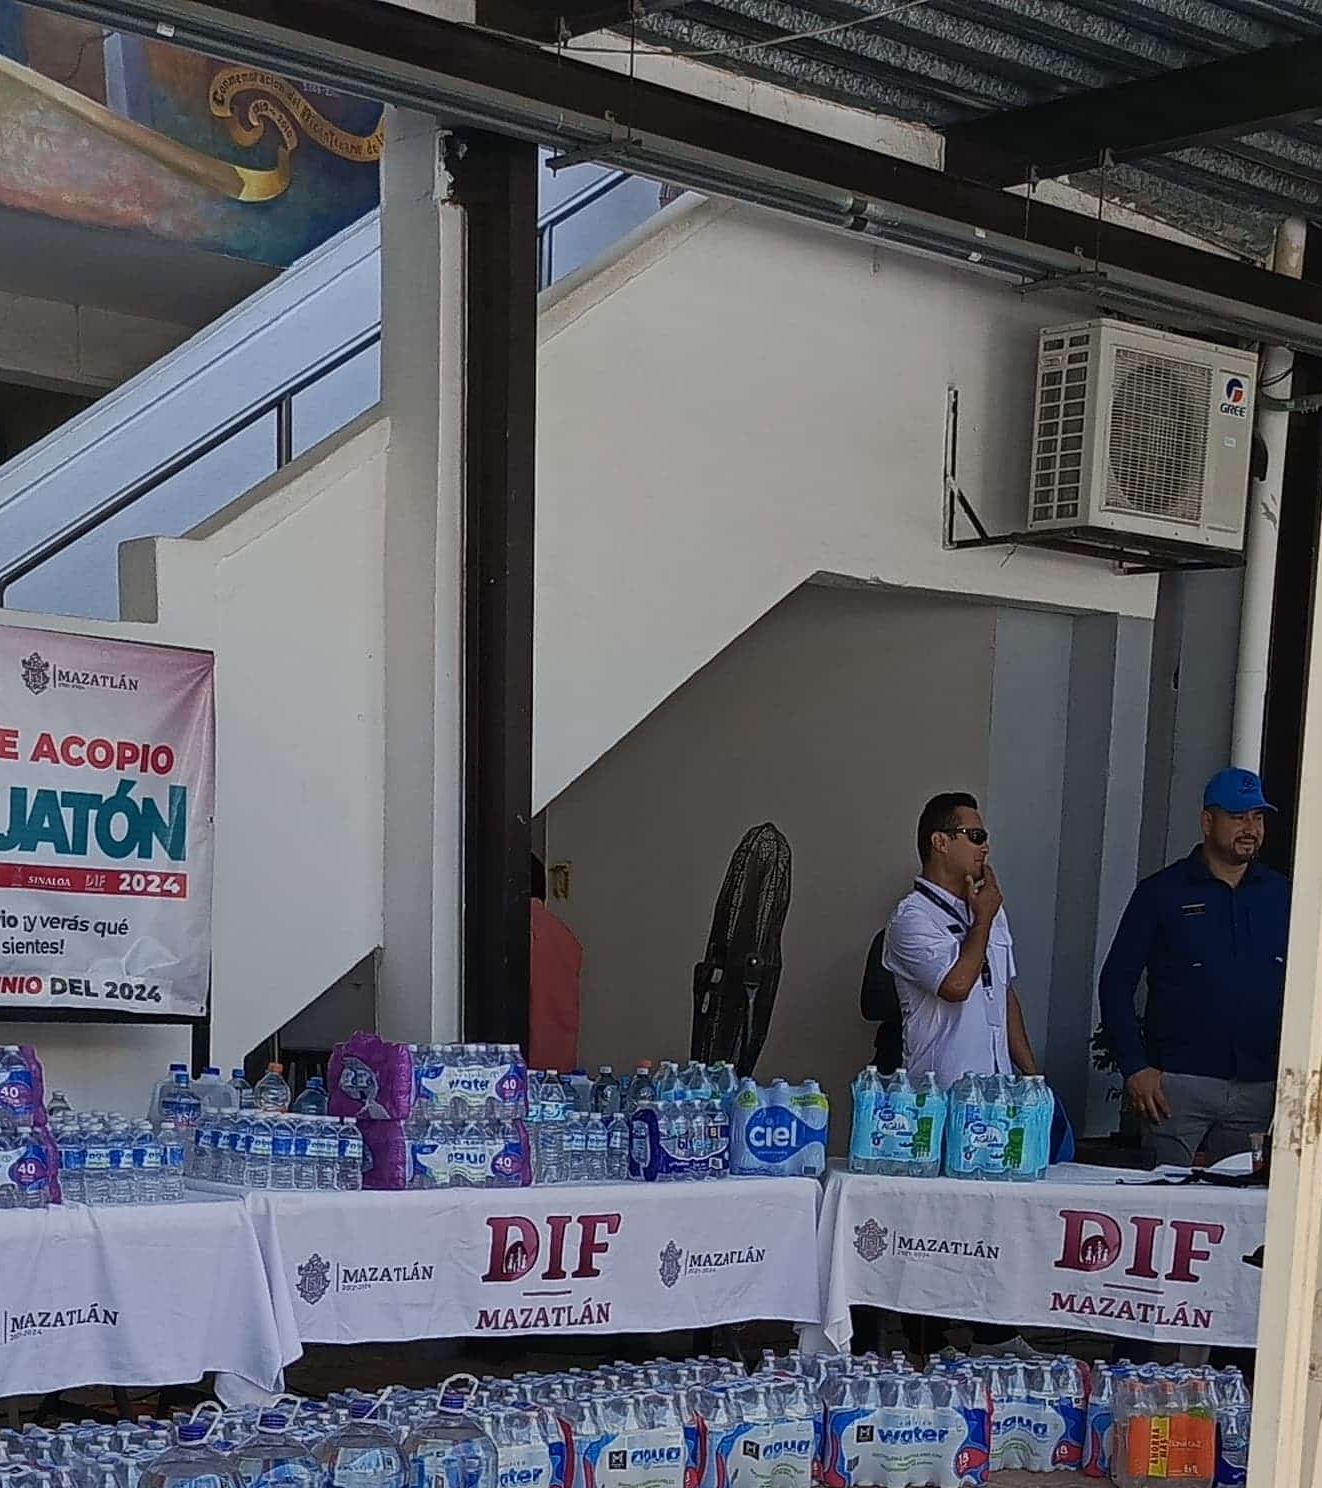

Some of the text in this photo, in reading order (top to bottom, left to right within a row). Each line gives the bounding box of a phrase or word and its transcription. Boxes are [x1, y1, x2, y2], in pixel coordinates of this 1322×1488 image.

[58, 670, 139, 690] MAZATLÁN
[30, 732, 175, 776] ACOPIO
[27, 875, 71, 887] SINALOA
[118, 873, 181, 894] 2024
[39, 912, 89, 933] verás
[94, 916, 129, 938] qué
[1, 938, 65, 956] sientes!
[49, 976, 100, 999] DEL
[103, 980, 162, 1003] 2024
[0, 1085, 19, 1099] 40
[748, 1117, 797, 1147] ciel
[17, 1163, 36, 1175] 40
[481, 1213, 622, 1283] DIF
[688, 1246, 766, 1268] MAZATLÁN
[897, 1237, 1001, 1260] MAZATLÁN
[1054, 1209, 1225, 1283] DIF
[342, 1261, 434, 1285] MAZATLÁN
[10, 1303, 119, 1333] MAZATLÁN
[475, 1297, 612, 1330] MAZATLÁN
[1050, 1292, 1214, 1329] MAZATLÁN
[878, 1428, 950, 1445] water
[498, 1466, 543, 1488] ater
